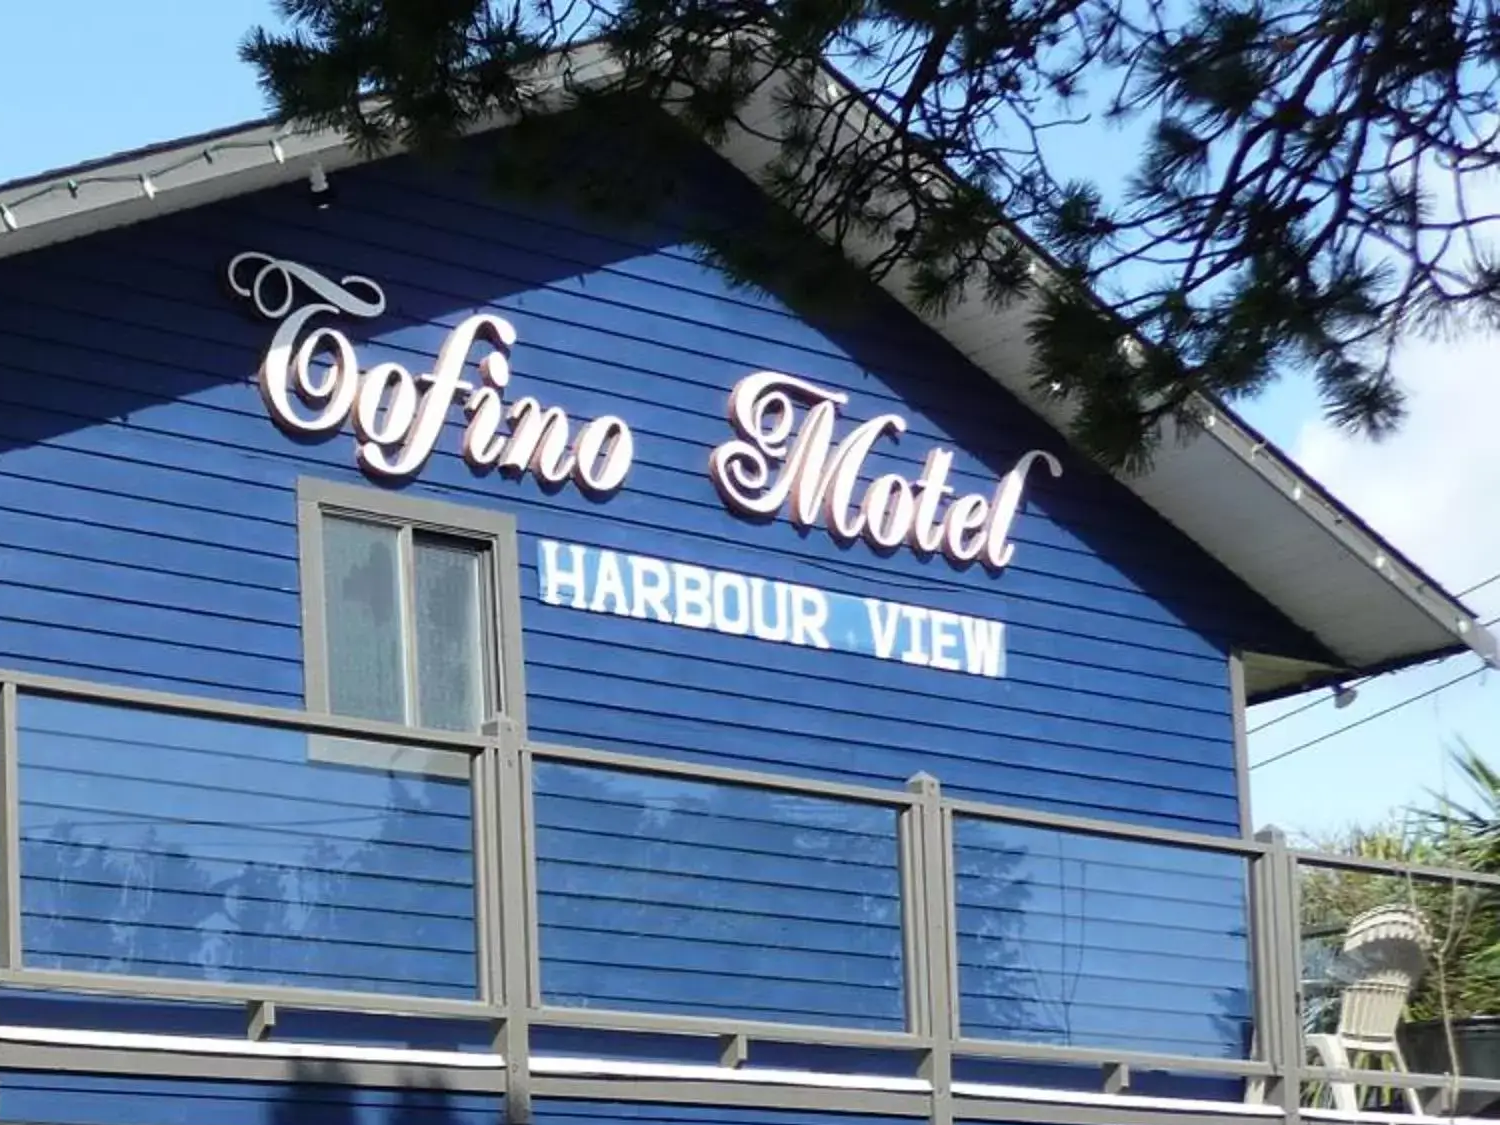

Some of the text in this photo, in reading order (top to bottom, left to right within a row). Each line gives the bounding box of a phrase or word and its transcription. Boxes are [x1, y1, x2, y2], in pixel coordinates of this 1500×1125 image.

[227, 250, 1063, 570] Tofino Motel
[538, 538, 1007, 678] HARBOUR VIEW
